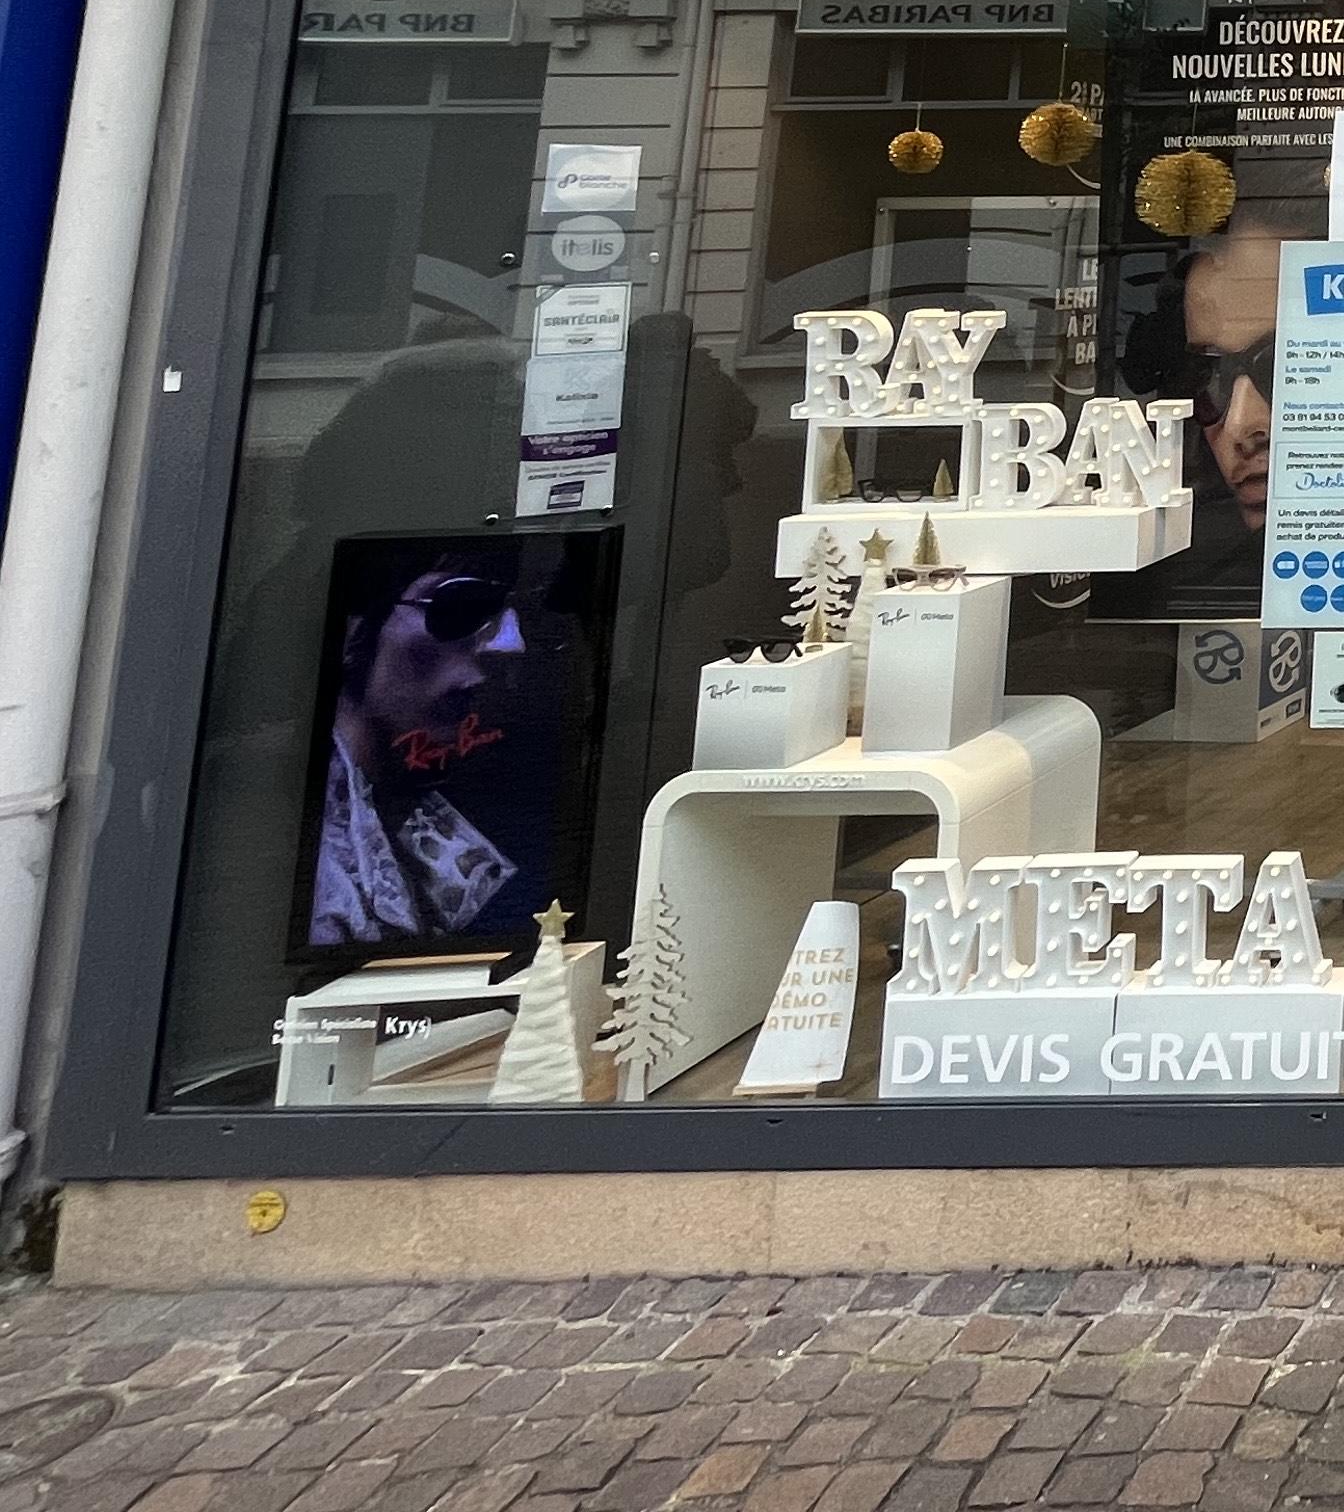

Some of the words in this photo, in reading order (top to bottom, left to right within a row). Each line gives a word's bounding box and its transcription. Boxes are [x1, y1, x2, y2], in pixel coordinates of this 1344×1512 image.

[1220, 15, 1344, 45] DÉCOUVREZ
[1172, 54, 1293, 79] NOUVELLES
[1190, 89, 1200, 103] IA
[1204, 86, 1255, 103] AVANCÉE.
[1259, 88, 1286, 102] PLUS
[1289, 88, 1303, 101] DE
[1237, 108, 1295, 121] MEILLEURE
[1164, 136, 1182, 148] UNE
[1185, 136, 1248, 148] COMBINAISON
[1251, 135, 1290, 146] PARFAITE
[1293, 134, 1316, 145] AVEC
[562, 240, 613, 256] itelis
[790, 308, 1006, 419] RAY
[971, 397, 1194, 511] BAN
[885, 850, 1333, 997] META
[385, 1017, 427, 1039] Krys
[890, 1033, 1071, 1084] DEVIS
